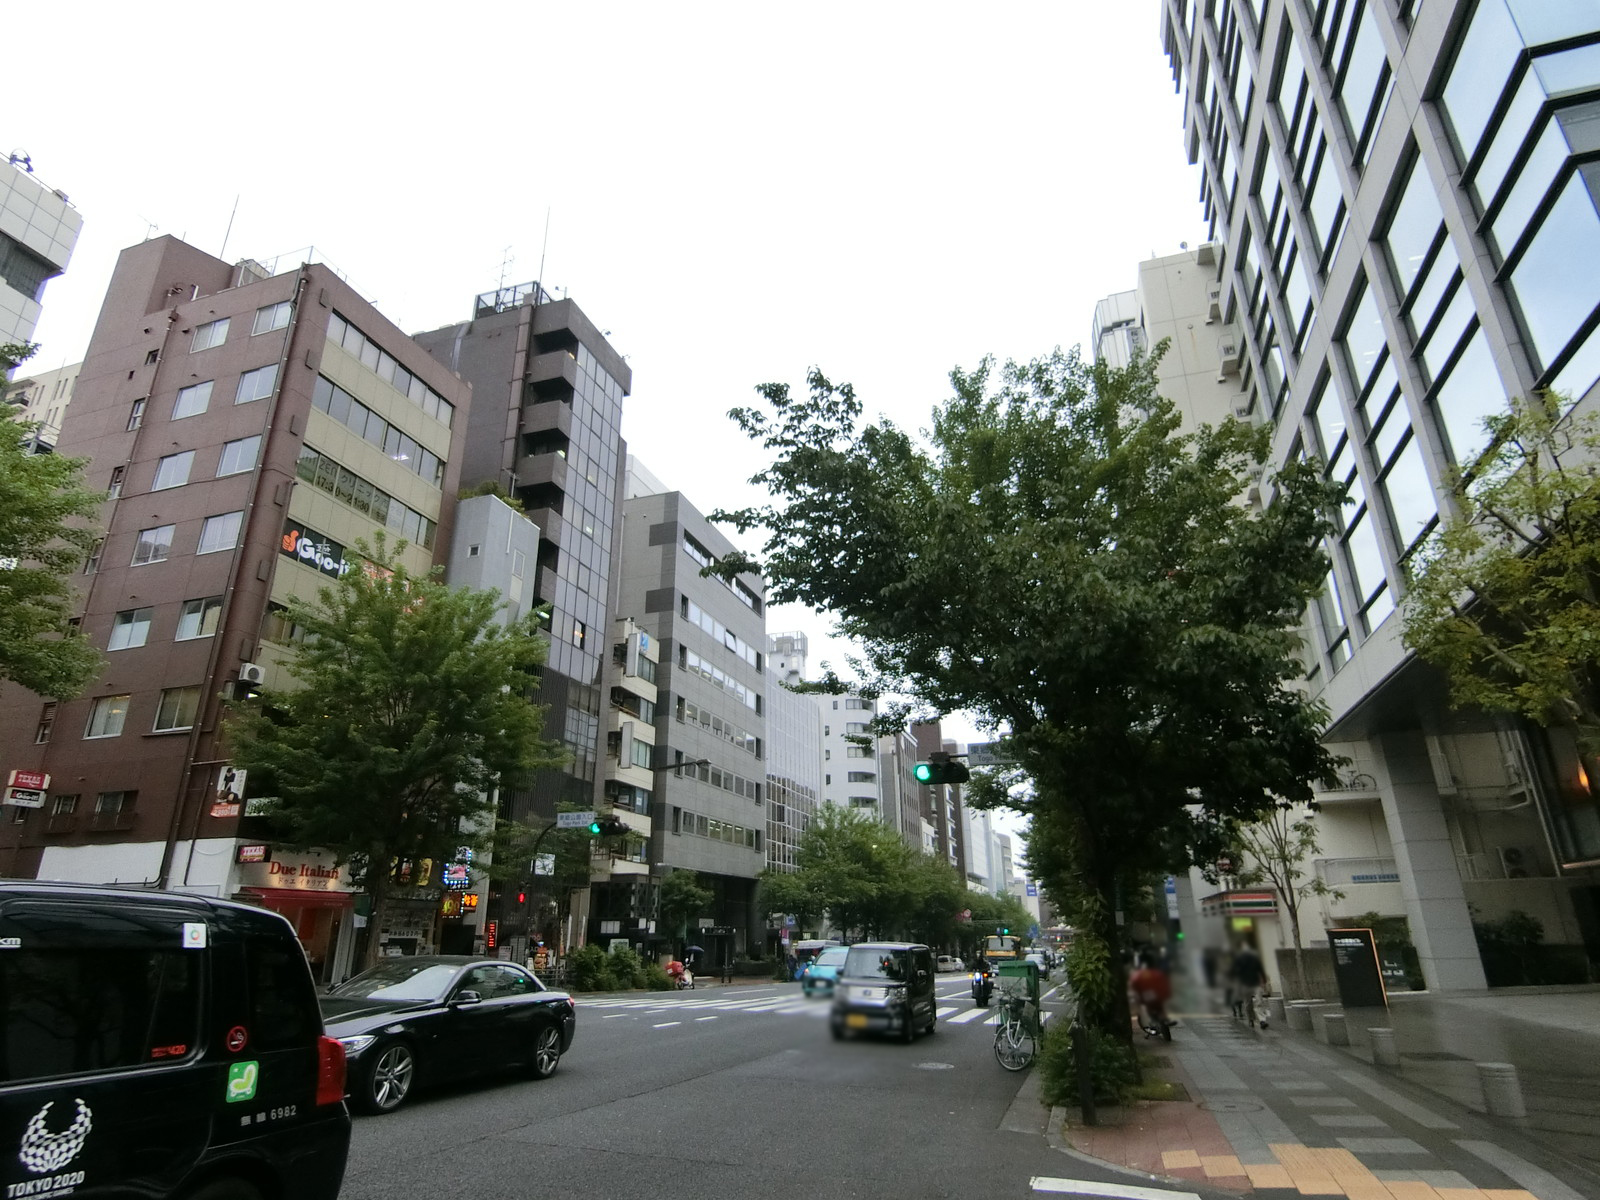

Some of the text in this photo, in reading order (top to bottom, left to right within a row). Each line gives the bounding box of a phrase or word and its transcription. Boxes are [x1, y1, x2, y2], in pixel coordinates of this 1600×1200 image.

[269, 861, 340, 880] Due Italian
[270, 1104, 297, 1120] 6982
[7, 1170, 86, 1198] TOKYO 2020
